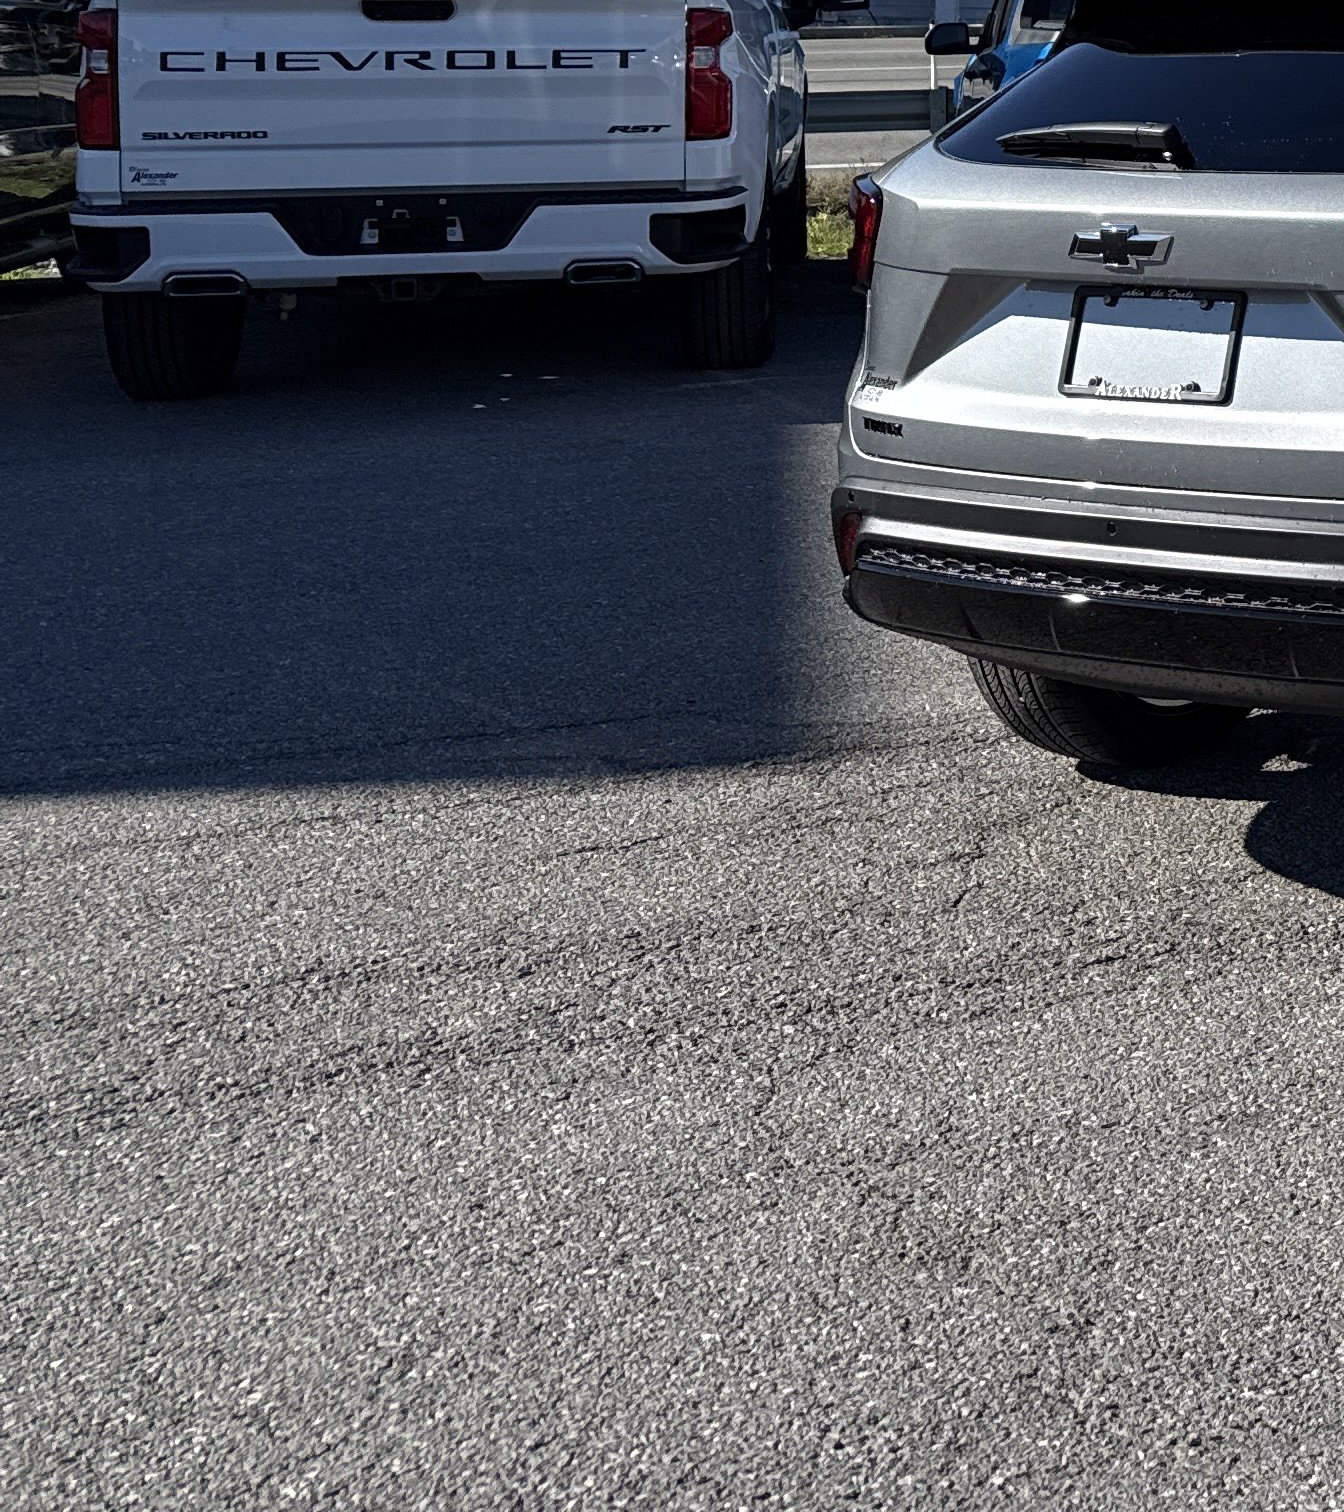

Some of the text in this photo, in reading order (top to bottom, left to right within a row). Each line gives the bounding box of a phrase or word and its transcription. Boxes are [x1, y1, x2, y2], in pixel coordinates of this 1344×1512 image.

[159, 49, 647, 72] CHEVROLET
[606, 124, 672, 134] RST
[141, 130, 268, 140] SILVERADO
